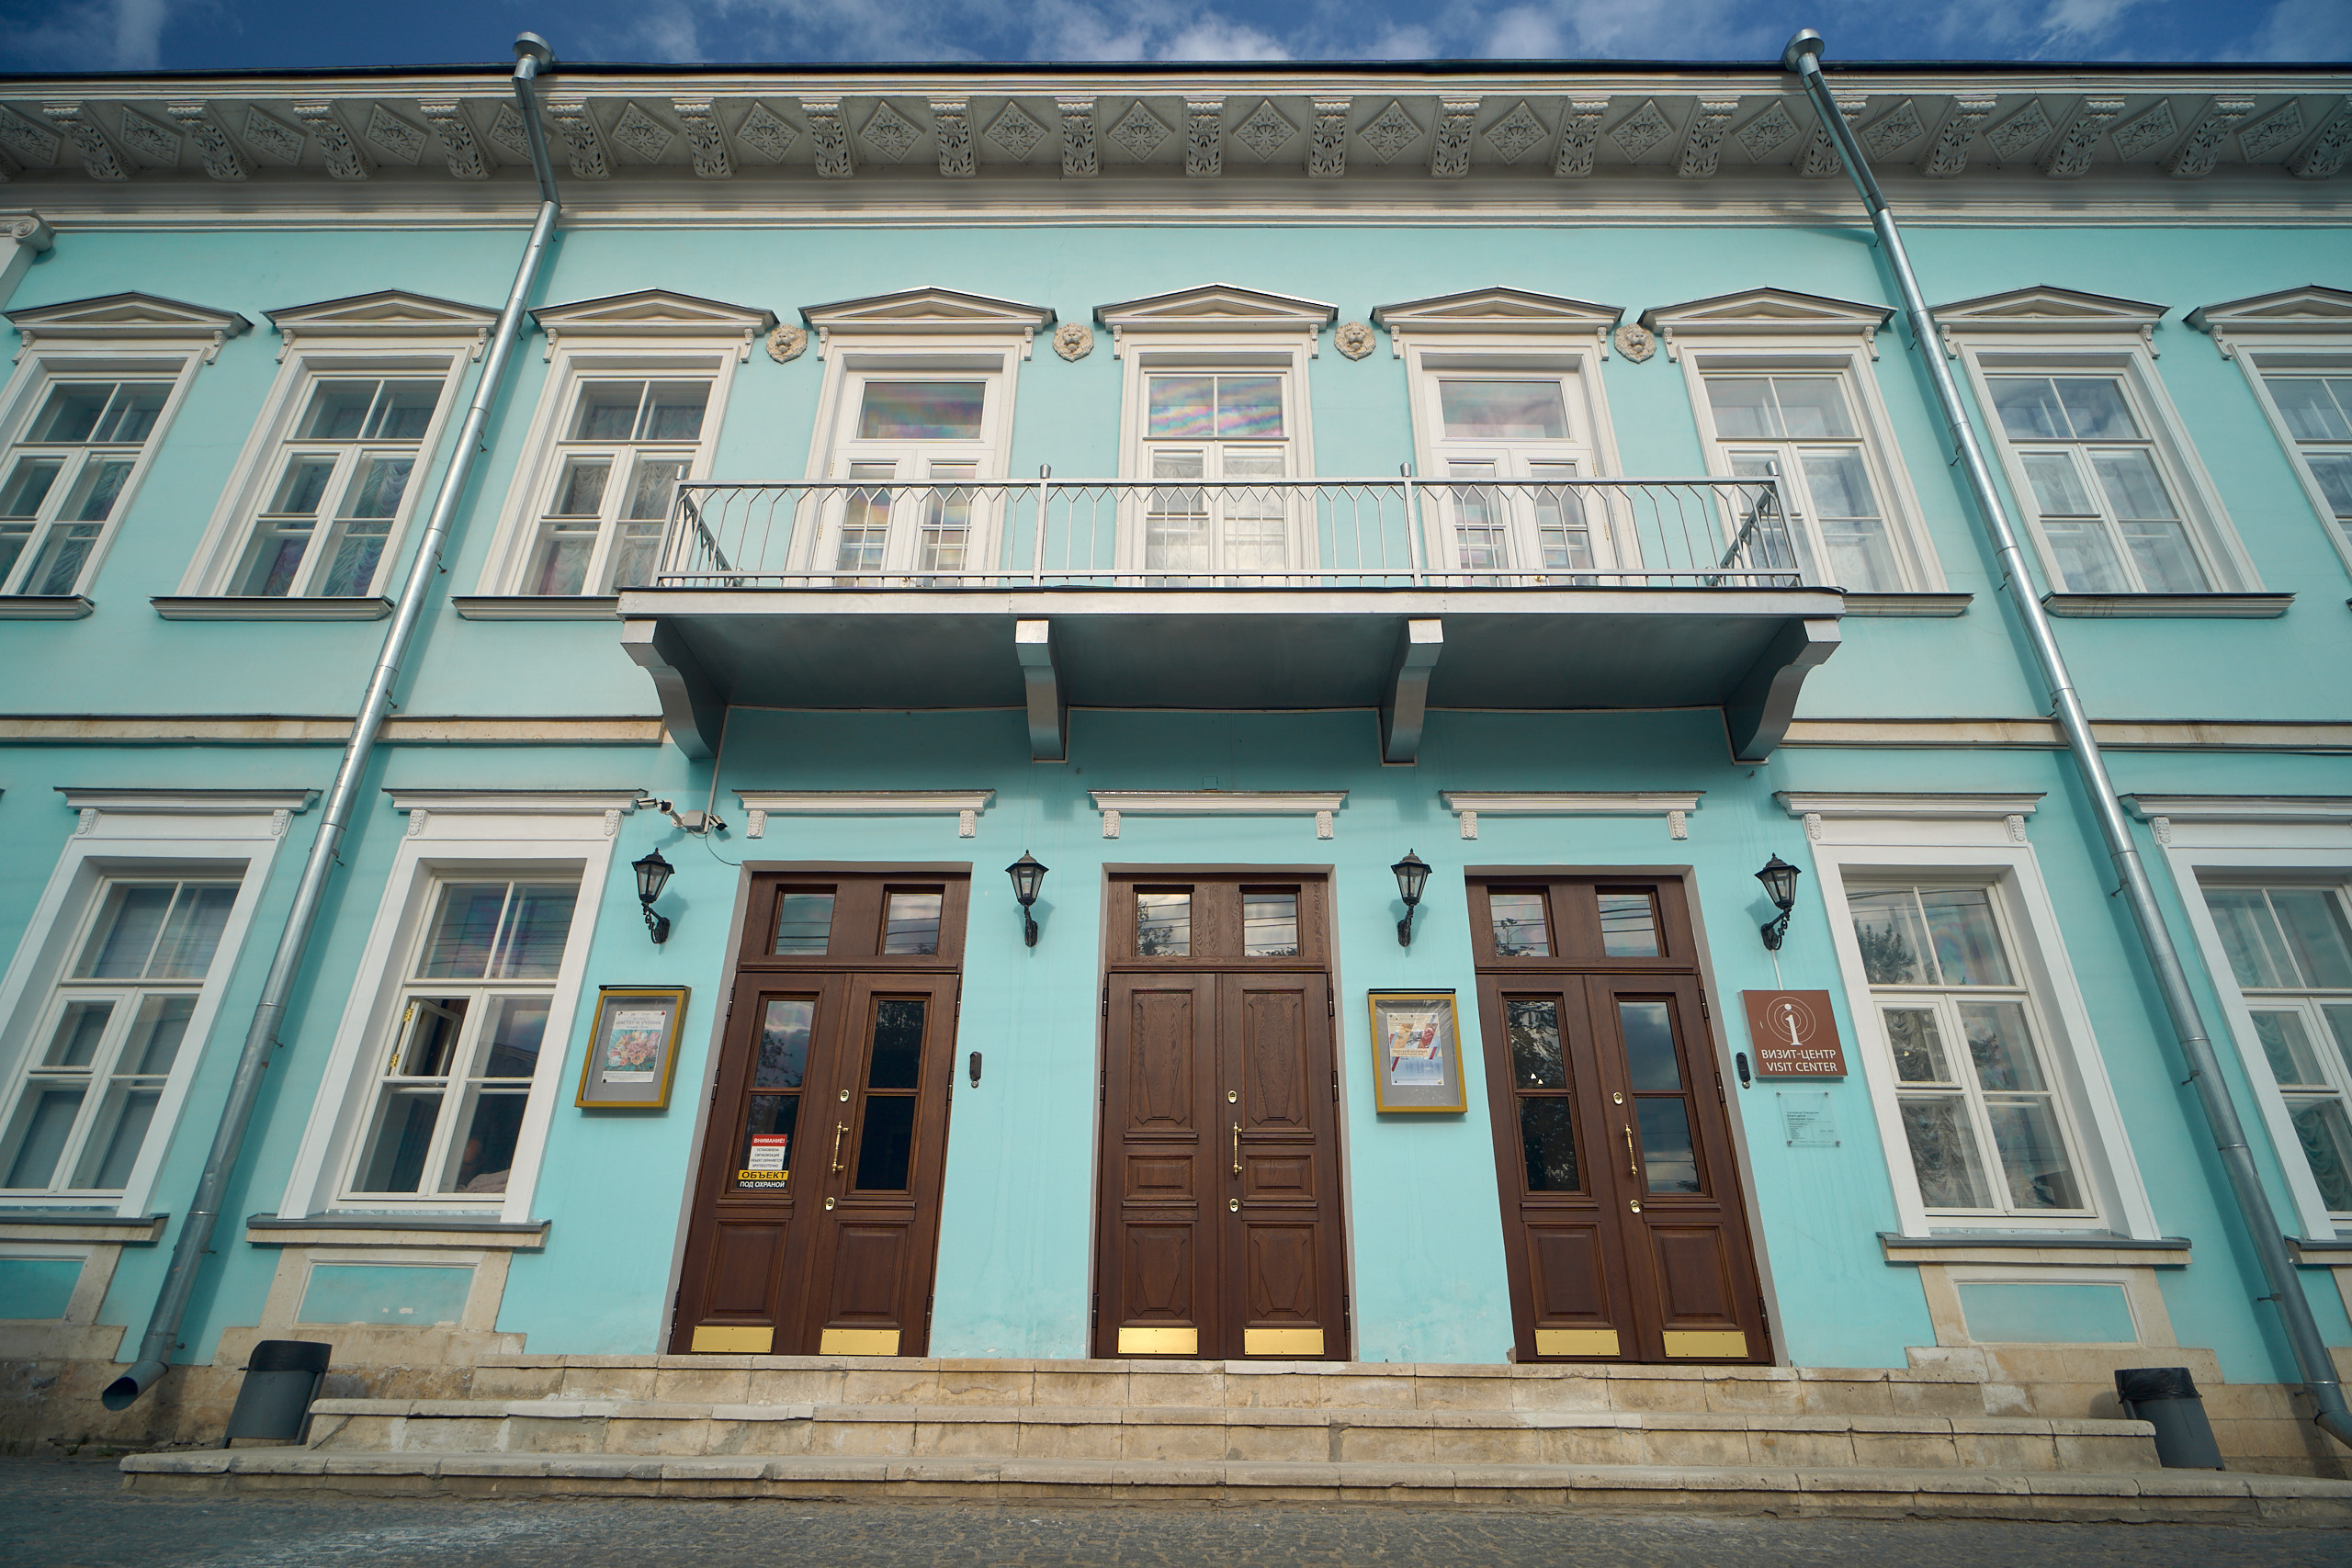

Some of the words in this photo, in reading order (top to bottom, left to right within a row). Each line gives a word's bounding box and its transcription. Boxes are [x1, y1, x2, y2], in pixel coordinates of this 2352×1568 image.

[1761, 1049, 1837, 1061] ВИЗИТ-ЦЕНТР
[1766, 1062, 1792, 1072] VISIT
[1795, 1062, 1838, 1072] CENTER
